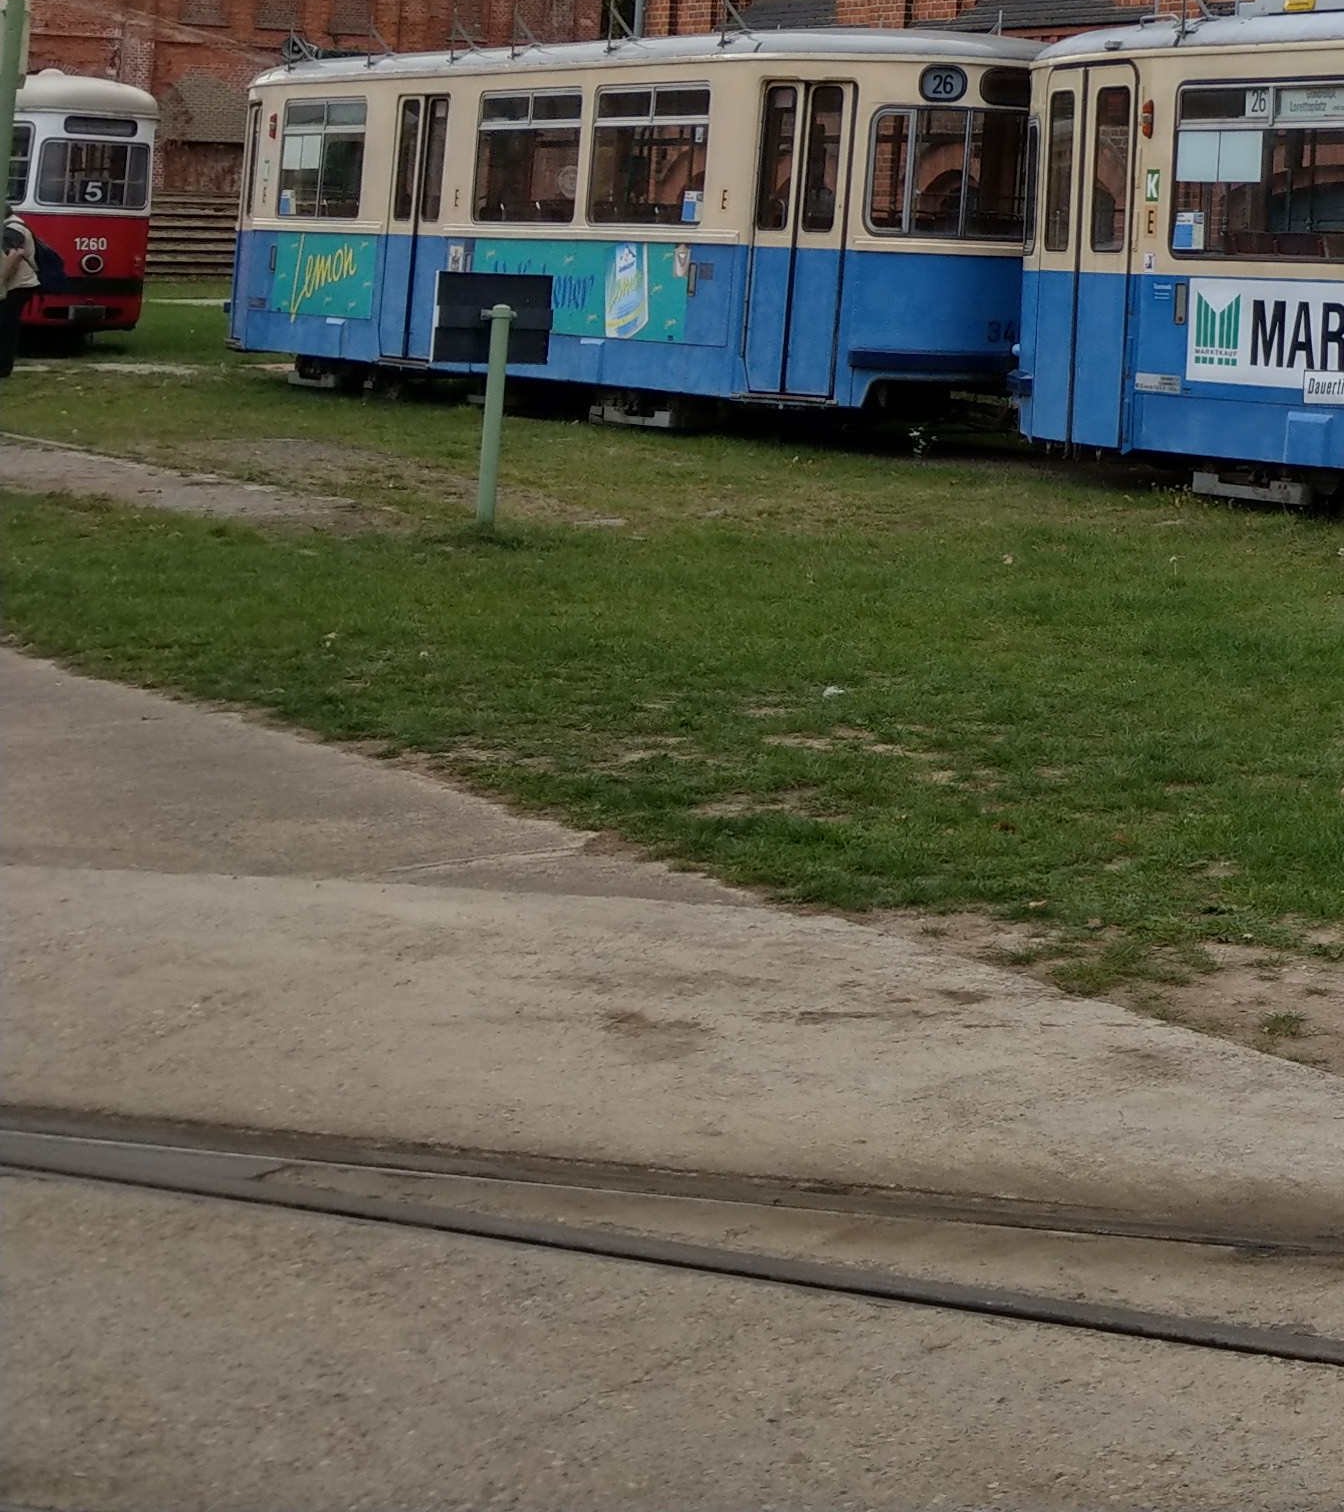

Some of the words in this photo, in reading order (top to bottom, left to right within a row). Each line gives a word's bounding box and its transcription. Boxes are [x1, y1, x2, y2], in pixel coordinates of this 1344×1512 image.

[932, 74, 954, 95] 26
[1251, 89, 1267, 113] 26
[84, 182, 103, 202] 5
[1146, 173, 1160, 198] K
[1147, 209, 1155, 234] E
[74, 238, 108, 251] 1260
[290, 232, 358, 324] Lemon
[1194, 348, 1239, 357] MARKTKAUF
